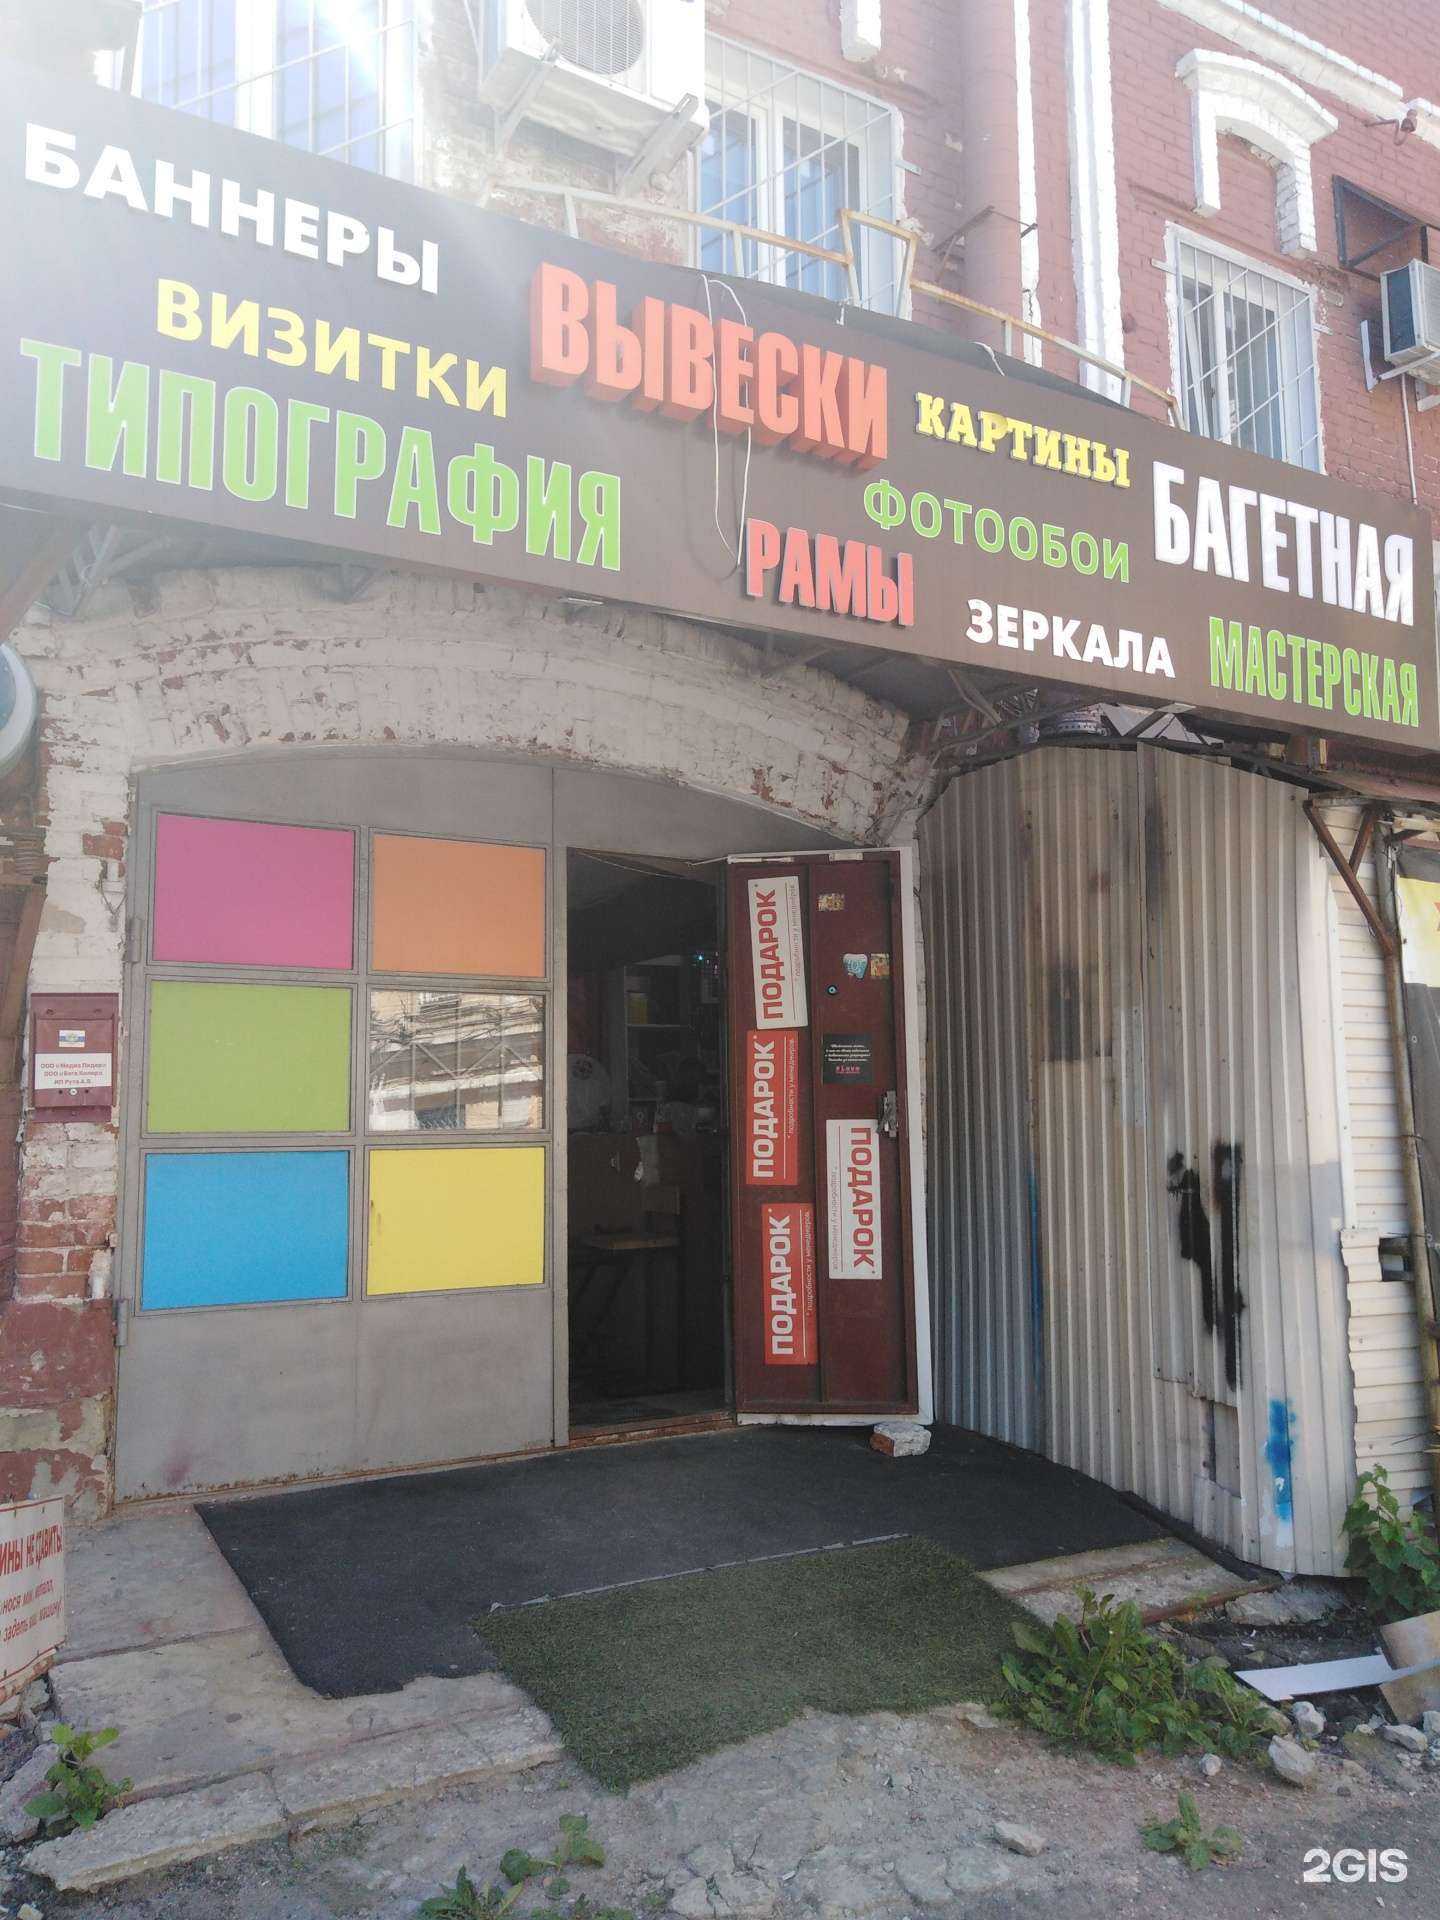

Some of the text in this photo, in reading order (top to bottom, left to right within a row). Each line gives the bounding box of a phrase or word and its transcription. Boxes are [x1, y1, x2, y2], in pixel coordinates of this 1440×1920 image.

[24, 122, 440, 295] БАННЕРЫ
[155, 277, 508, 418] ВИЗИТКИ
[533, 262, 888, 466] ВЫВЕСКИ
[20, 337, 622, 571] ТИПОГРАФИЯ
[915, 391, 1131, 488] КАРТИНЫ
[746, 517, 914, 626] РАМЫ
[863, 478, 1130, 583] ФОТООБОИ
[1152, 461, 1415, 626] БАГЕТНАЯ
[965, 598, 1176, 679] ЗЕРКАЛА
[1208, 615, 1420, 728] МАСТЕРСКАЯ
